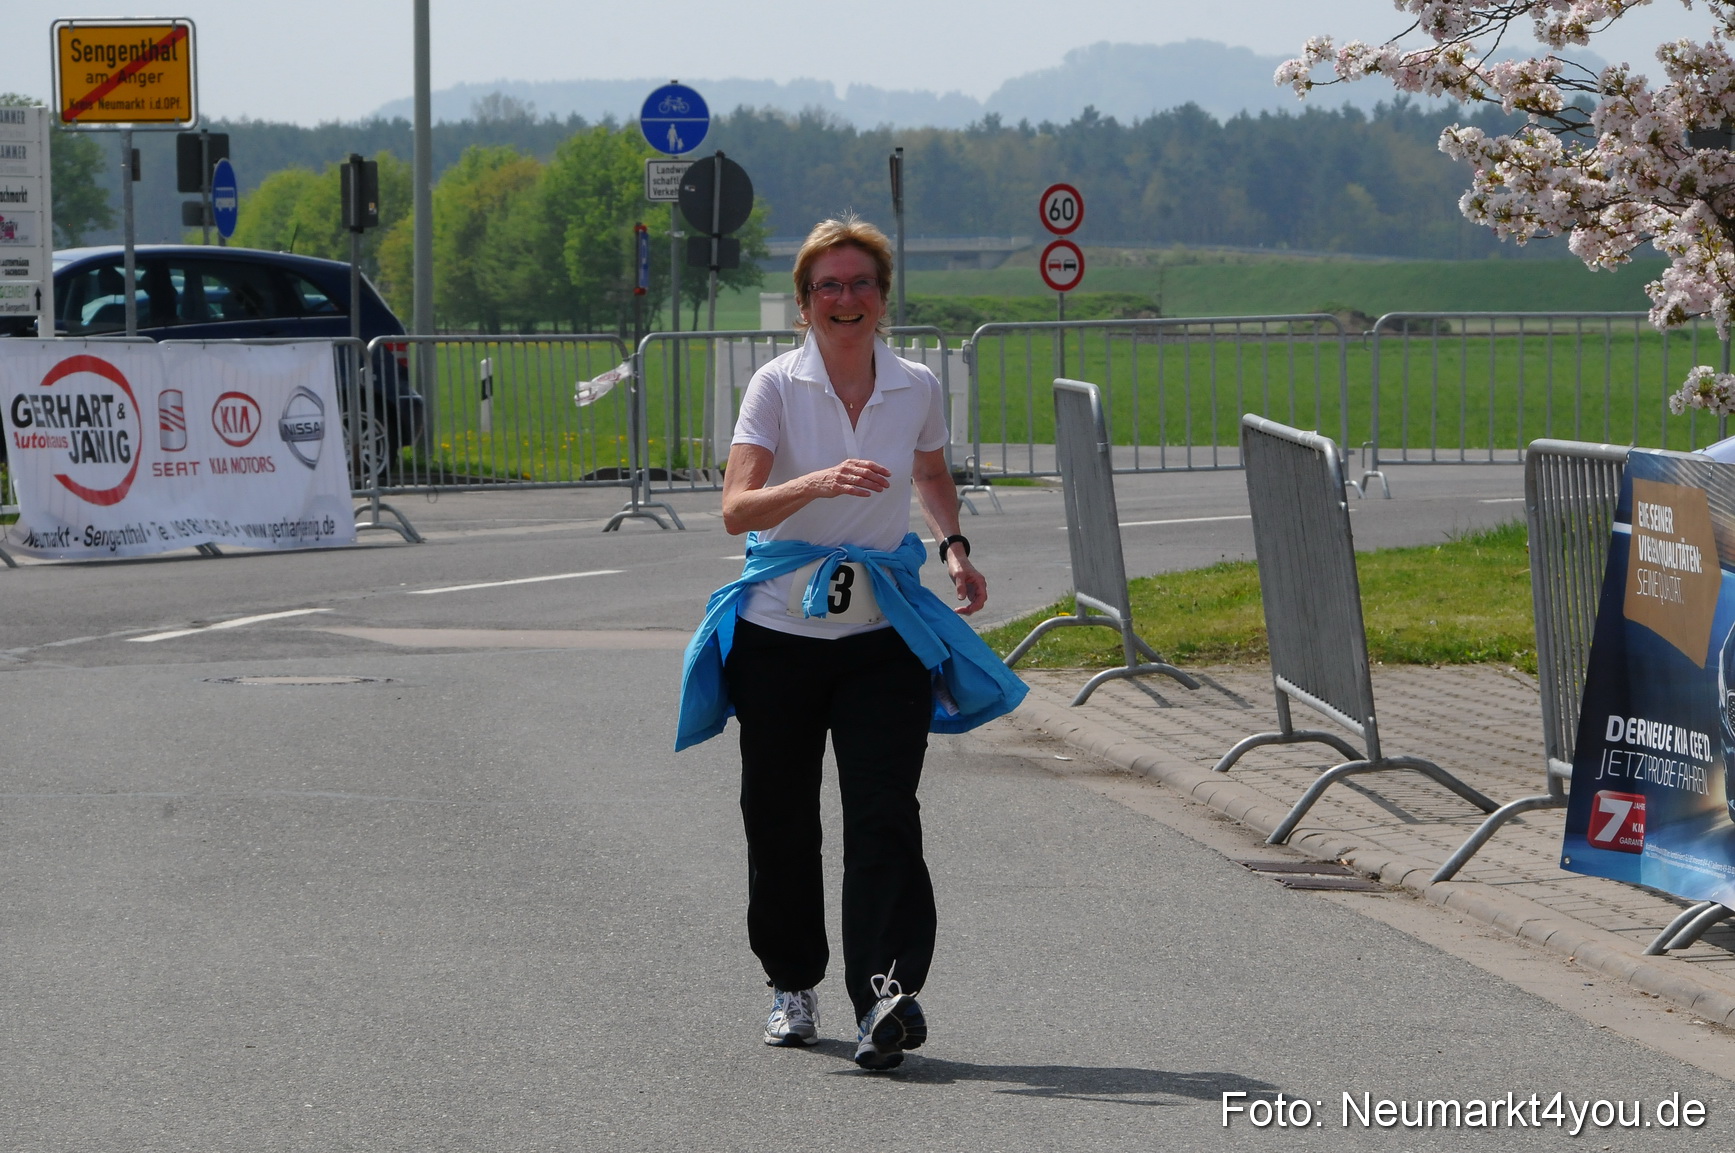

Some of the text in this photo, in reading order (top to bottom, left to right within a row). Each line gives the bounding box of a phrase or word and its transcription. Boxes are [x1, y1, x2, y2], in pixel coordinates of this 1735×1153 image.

[71, 37, 178, 68] Sengenthal
[85, 69, 164, 87] am Anger
[69, 98, 94, 111] Kreis
[98, 98, 145, 110] Neumarkt
[653, 187, 679, 197] Verkeh
[1049, 197, 1075, 222] 60
[11, 393, 126, 429] GERHART &
[220, 405, 251, 434] KIA
[283, 421, 321, 436] NISSA
[68, 429, 131, 464] JÄNIG
[152, 461, 200, 477] SEAT
[208, 455, 276, 475] KIA MOTORS
[83, 522, 148, 551] Sengenthal
[827, 563, 855, 615] 3
[1605, 714, 1647, 746] DER
[1646, 720, 1673, 753] NEUE
[1674, 726, 1689, 757] KIA
[1648, 754, 1677, 788] PROBE
[1593, 797, 1634, 843] 7
[1631, 822, 1645, 834] KIA
